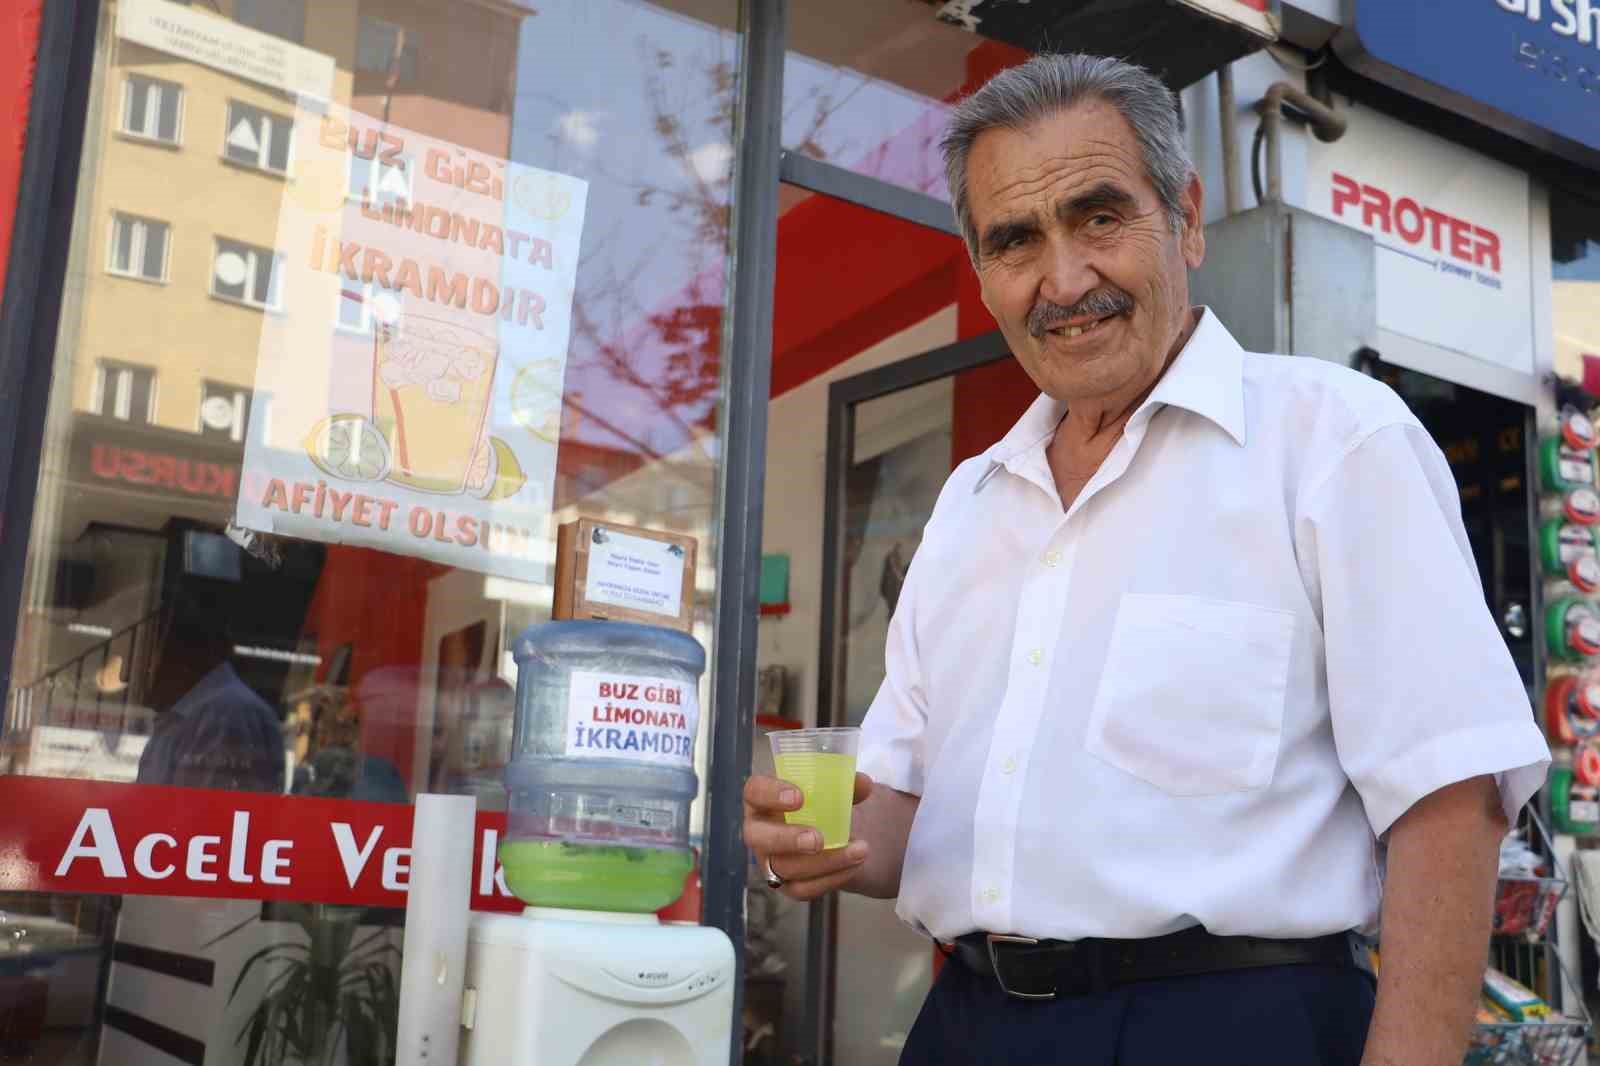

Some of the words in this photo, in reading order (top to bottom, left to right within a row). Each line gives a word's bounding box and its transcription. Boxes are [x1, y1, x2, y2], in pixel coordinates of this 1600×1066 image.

[1331, 170, 1502, 273] PROTER
[307, 222, 546, 331] İKRAMDIR
[261, 477, 399, 531] AFİYET
[591, 702, 686, 730] LİMONATA
[598, 681, 640, 700] BUZ
[644, 682, 682, 706] GİBİ
[574, 720, 692, 758] İKRAMDIR
